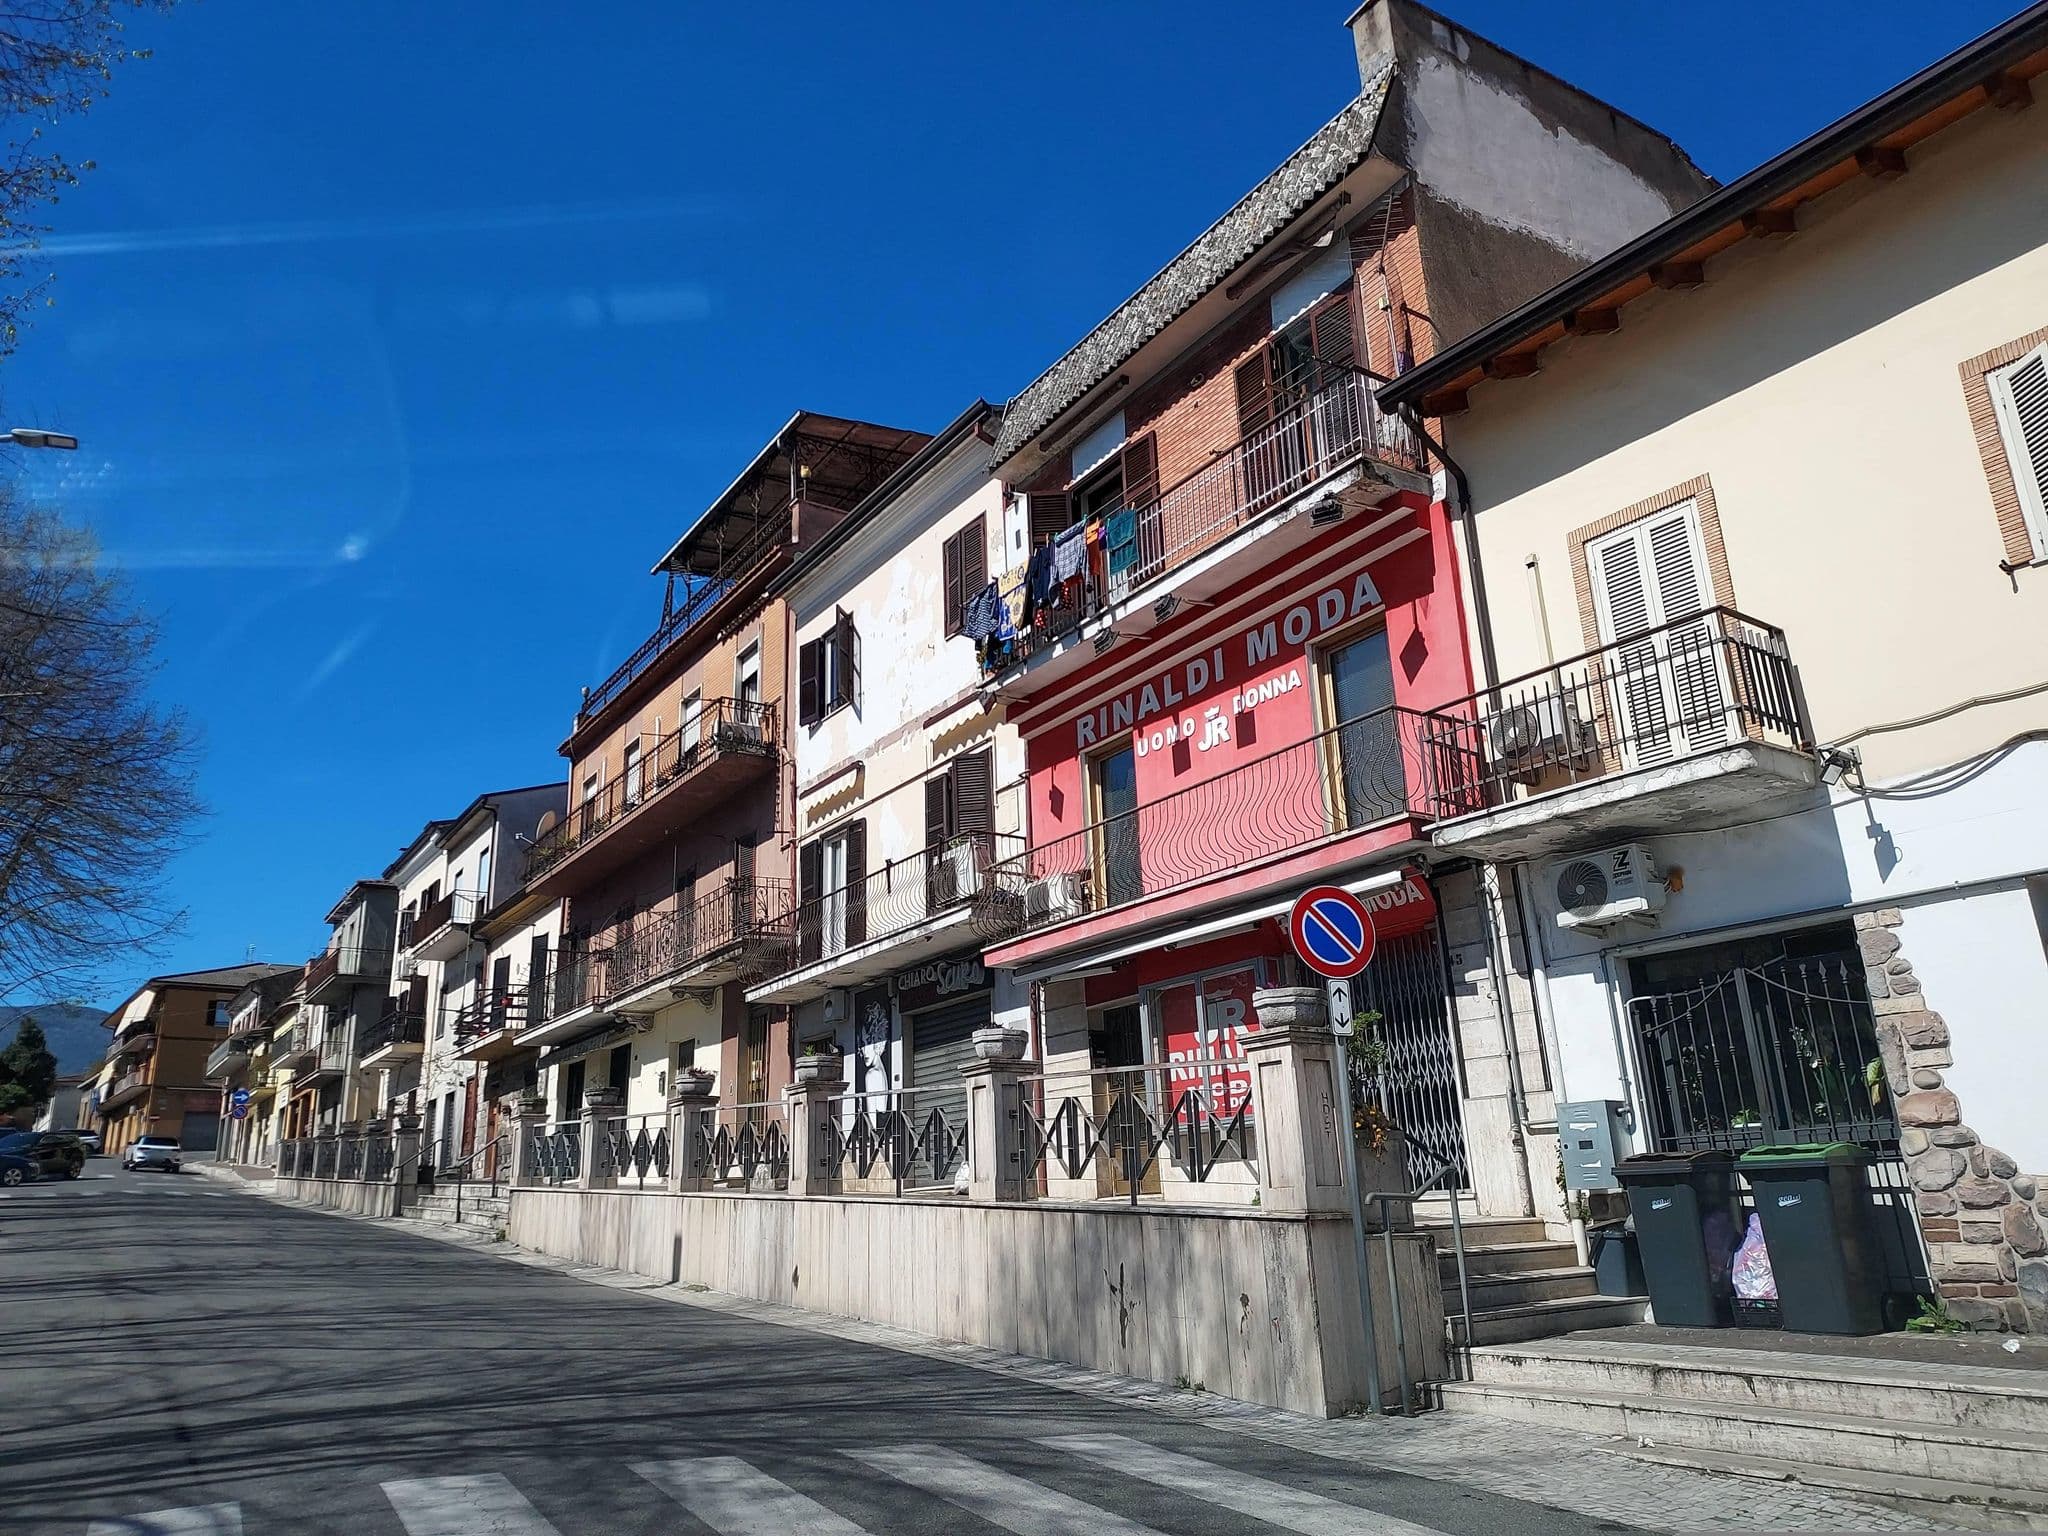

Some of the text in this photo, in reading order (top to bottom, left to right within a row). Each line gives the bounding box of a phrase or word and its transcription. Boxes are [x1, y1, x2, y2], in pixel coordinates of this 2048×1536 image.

[1076, 572, 1384, 750] RINALDI MODA
[1137, 669, 1303, 758] UOMO JR DONNA
[898, 966, 938, 991] CHIARO
